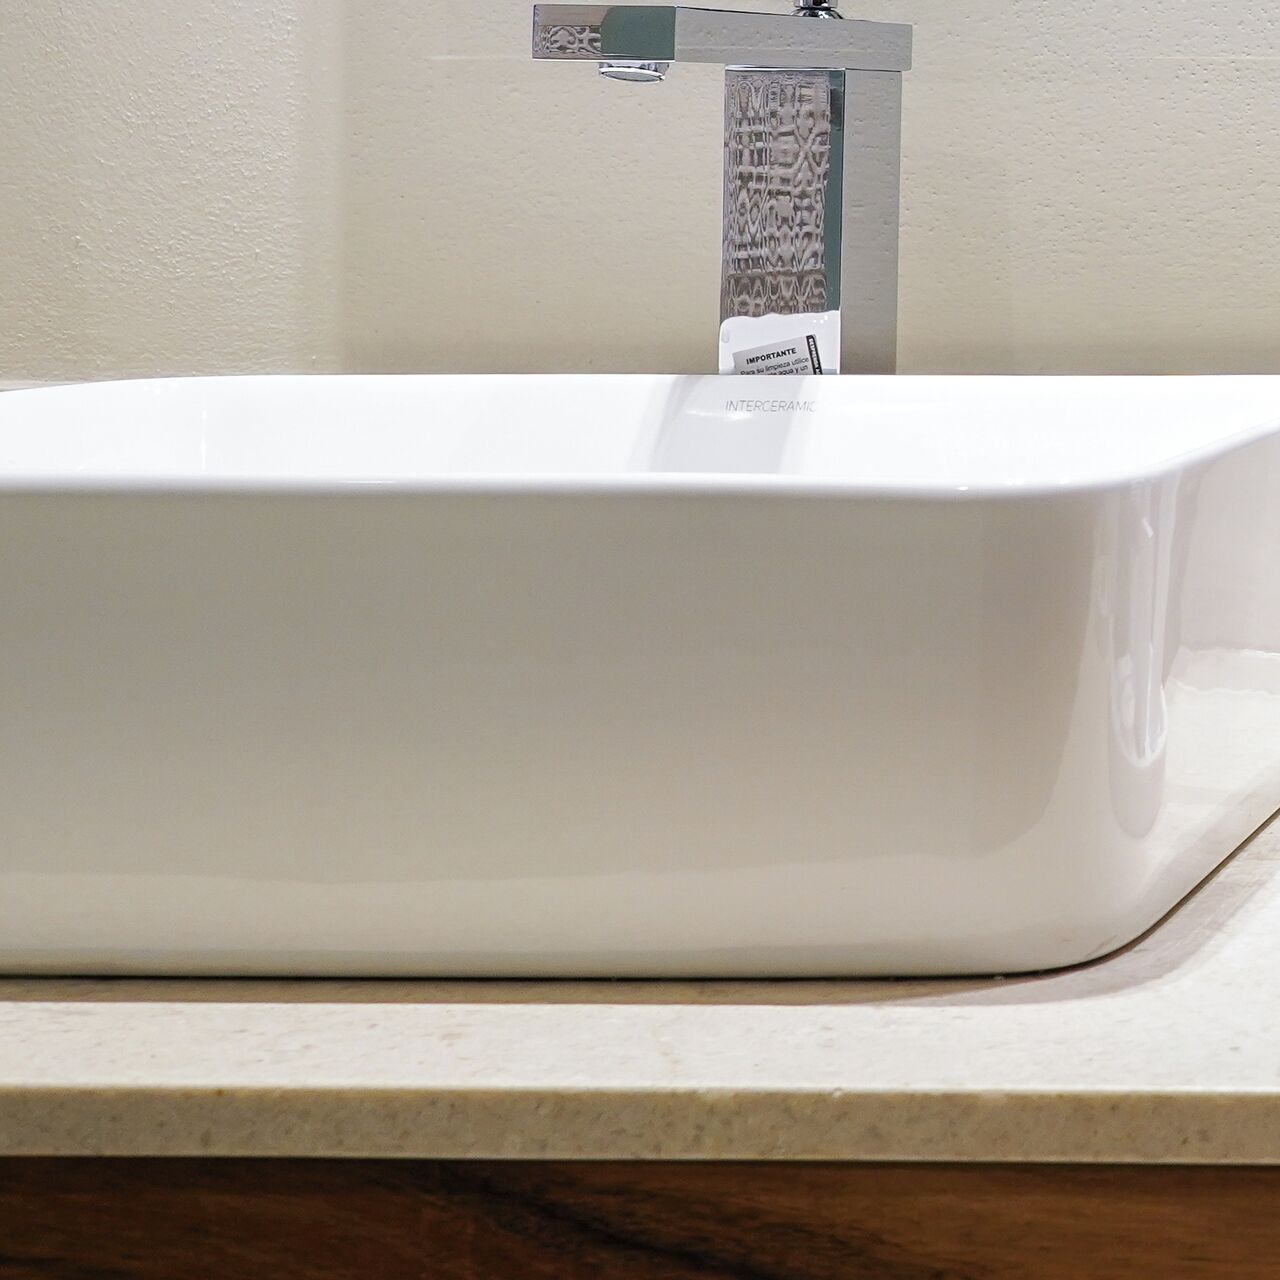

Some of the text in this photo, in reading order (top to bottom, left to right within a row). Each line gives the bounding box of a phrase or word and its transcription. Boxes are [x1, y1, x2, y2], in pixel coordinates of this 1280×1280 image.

[746, 347, 797, 365] IMPORTANTE
[765, 362, 790, 372] limpieza
[725, 399, 817, 412] INTERCERAMIC
